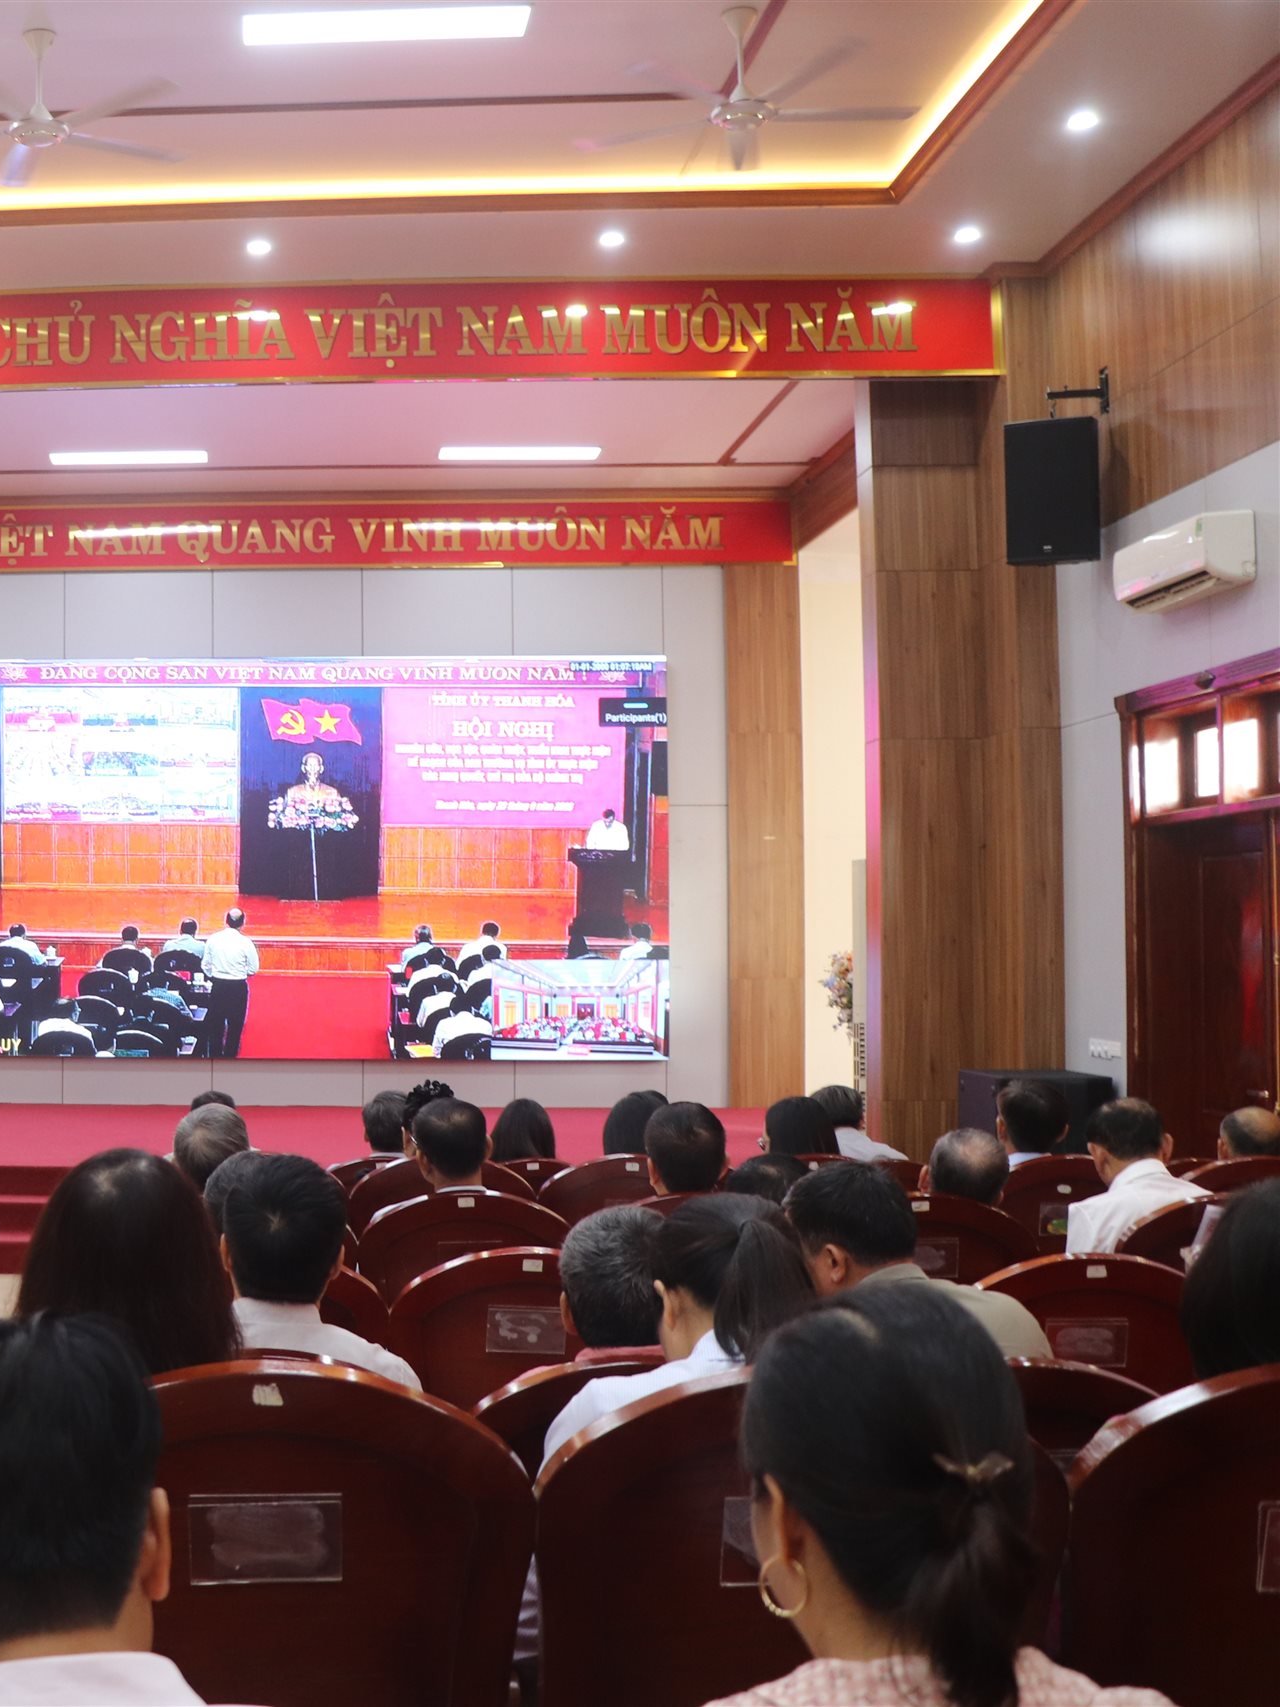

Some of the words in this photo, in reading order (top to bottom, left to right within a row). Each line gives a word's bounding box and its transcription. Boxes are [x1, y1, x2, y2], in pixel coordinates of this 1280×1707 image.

[110, 299, 296, 363] NGHĨA
[304, 292, 443, 369] VIỆT
[457, 304, 589, 357] NAM
[601, 287, 768, 355] MUÔN
[784, 286, 918, 352] NĂM
[68, 520, 166, 557] NAM
[176, 517, 335, 564] QUANG
[348, 518, 465, 554] VINH
[476, 506, 608, 552] MUÔN
[623, 506, 724, 551] NĂM
[269, 666, 316, 680] NAM
[321, 666, 394, 683] QUANG
[398, 666, 454, 680] VINH
[452, 715, 493, 742] HỘI
[497, 721, 555, 742] NGHỊ
[605, 712, 666, 724] Participants(1)
